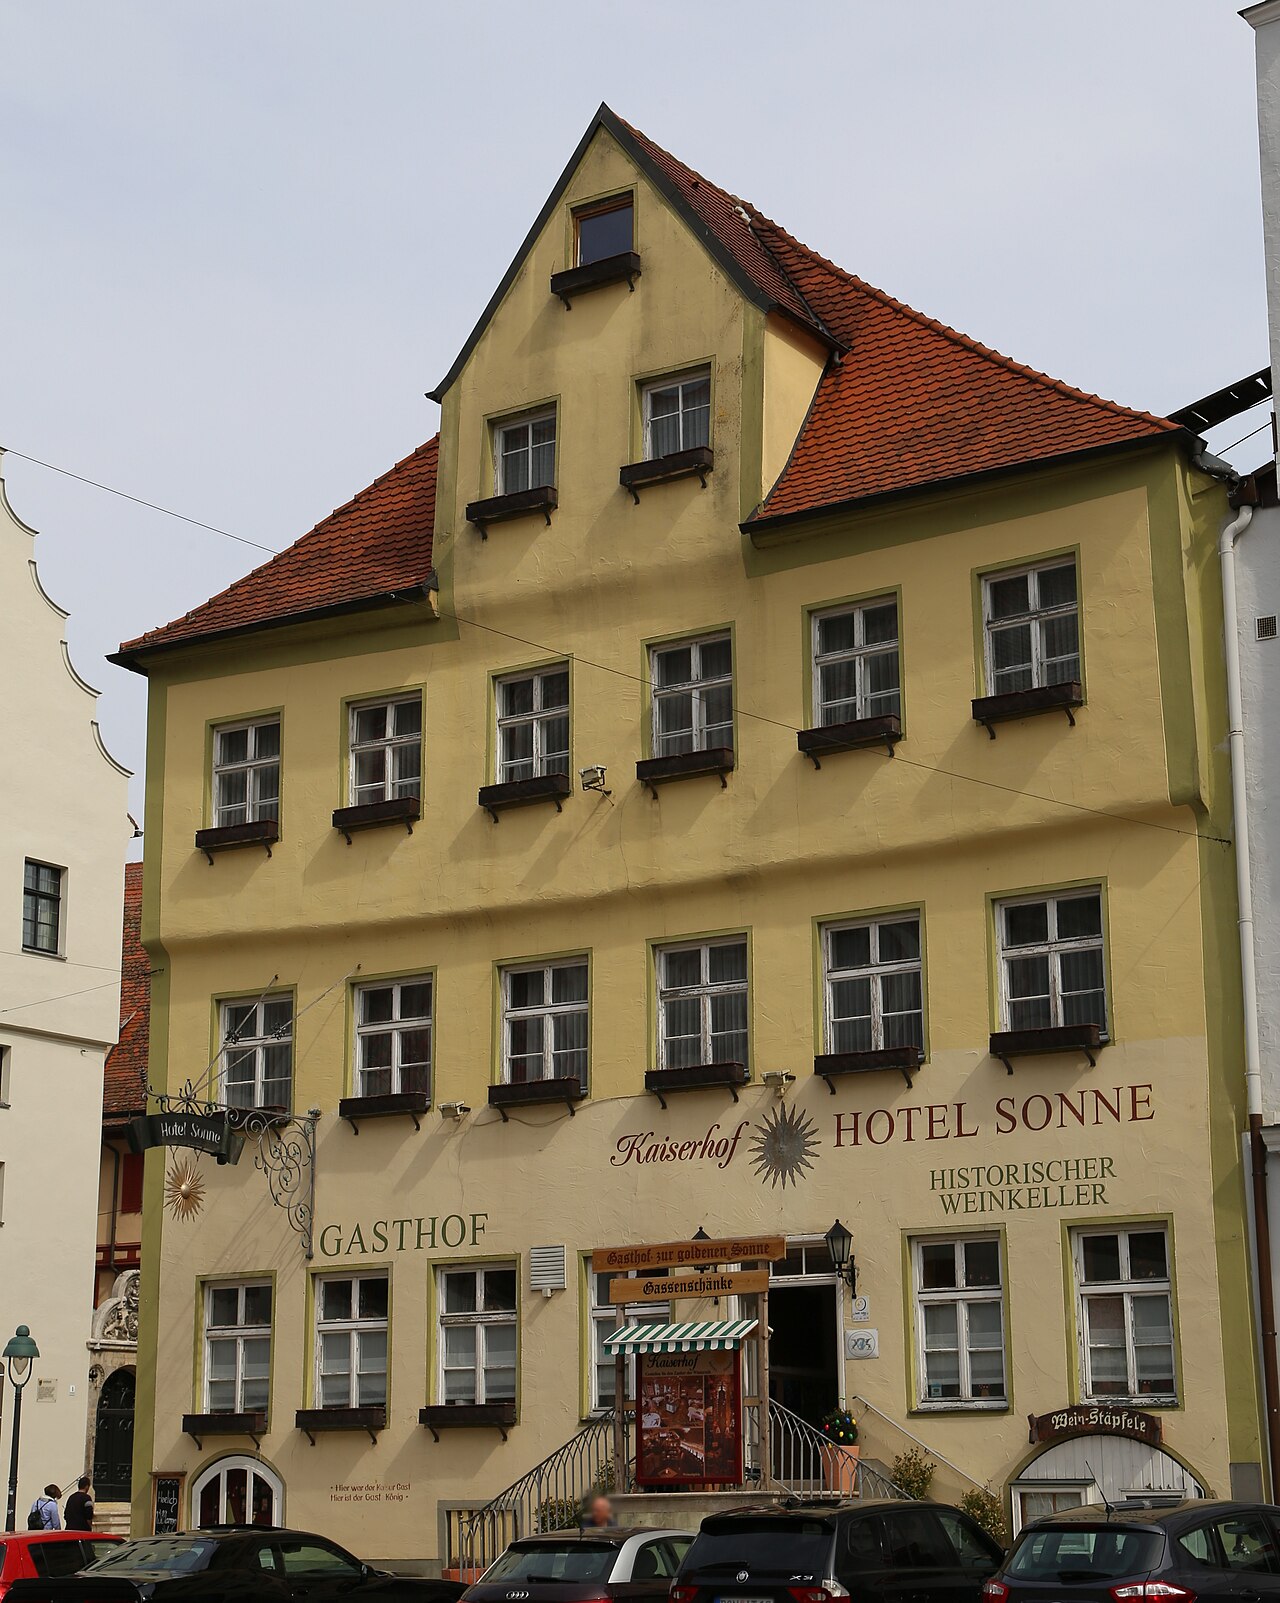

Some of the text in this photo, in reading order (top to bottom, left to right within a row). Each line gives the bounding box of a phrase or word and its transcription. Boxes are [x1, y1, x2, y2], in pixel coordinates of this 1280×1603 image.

[833, 1084, 1155, 1148] HOTEL SONNE
[161, 1122, 221, 1143] Hotel Sonne
[610, 1121, 750, 1169] Kaiserhof
[929, 1156, 1117, 1191] HISTORISCHER
[939, 1183, 1109, 1215] WEINKELLER
[319, 1213, 489, 1257] GASTHOF
[656, 1250, 674, 1264] zur
[677, 1245, 727, 1262] goldenen
[730, 1242, 770, 1256] Sonne
[642, 1276, 734, 1295] Gassenschänke
[647, 1353, 700, 1371] Kaiserhof
[1051, 1408, 1146, 1432] Wein-Stäpfele
